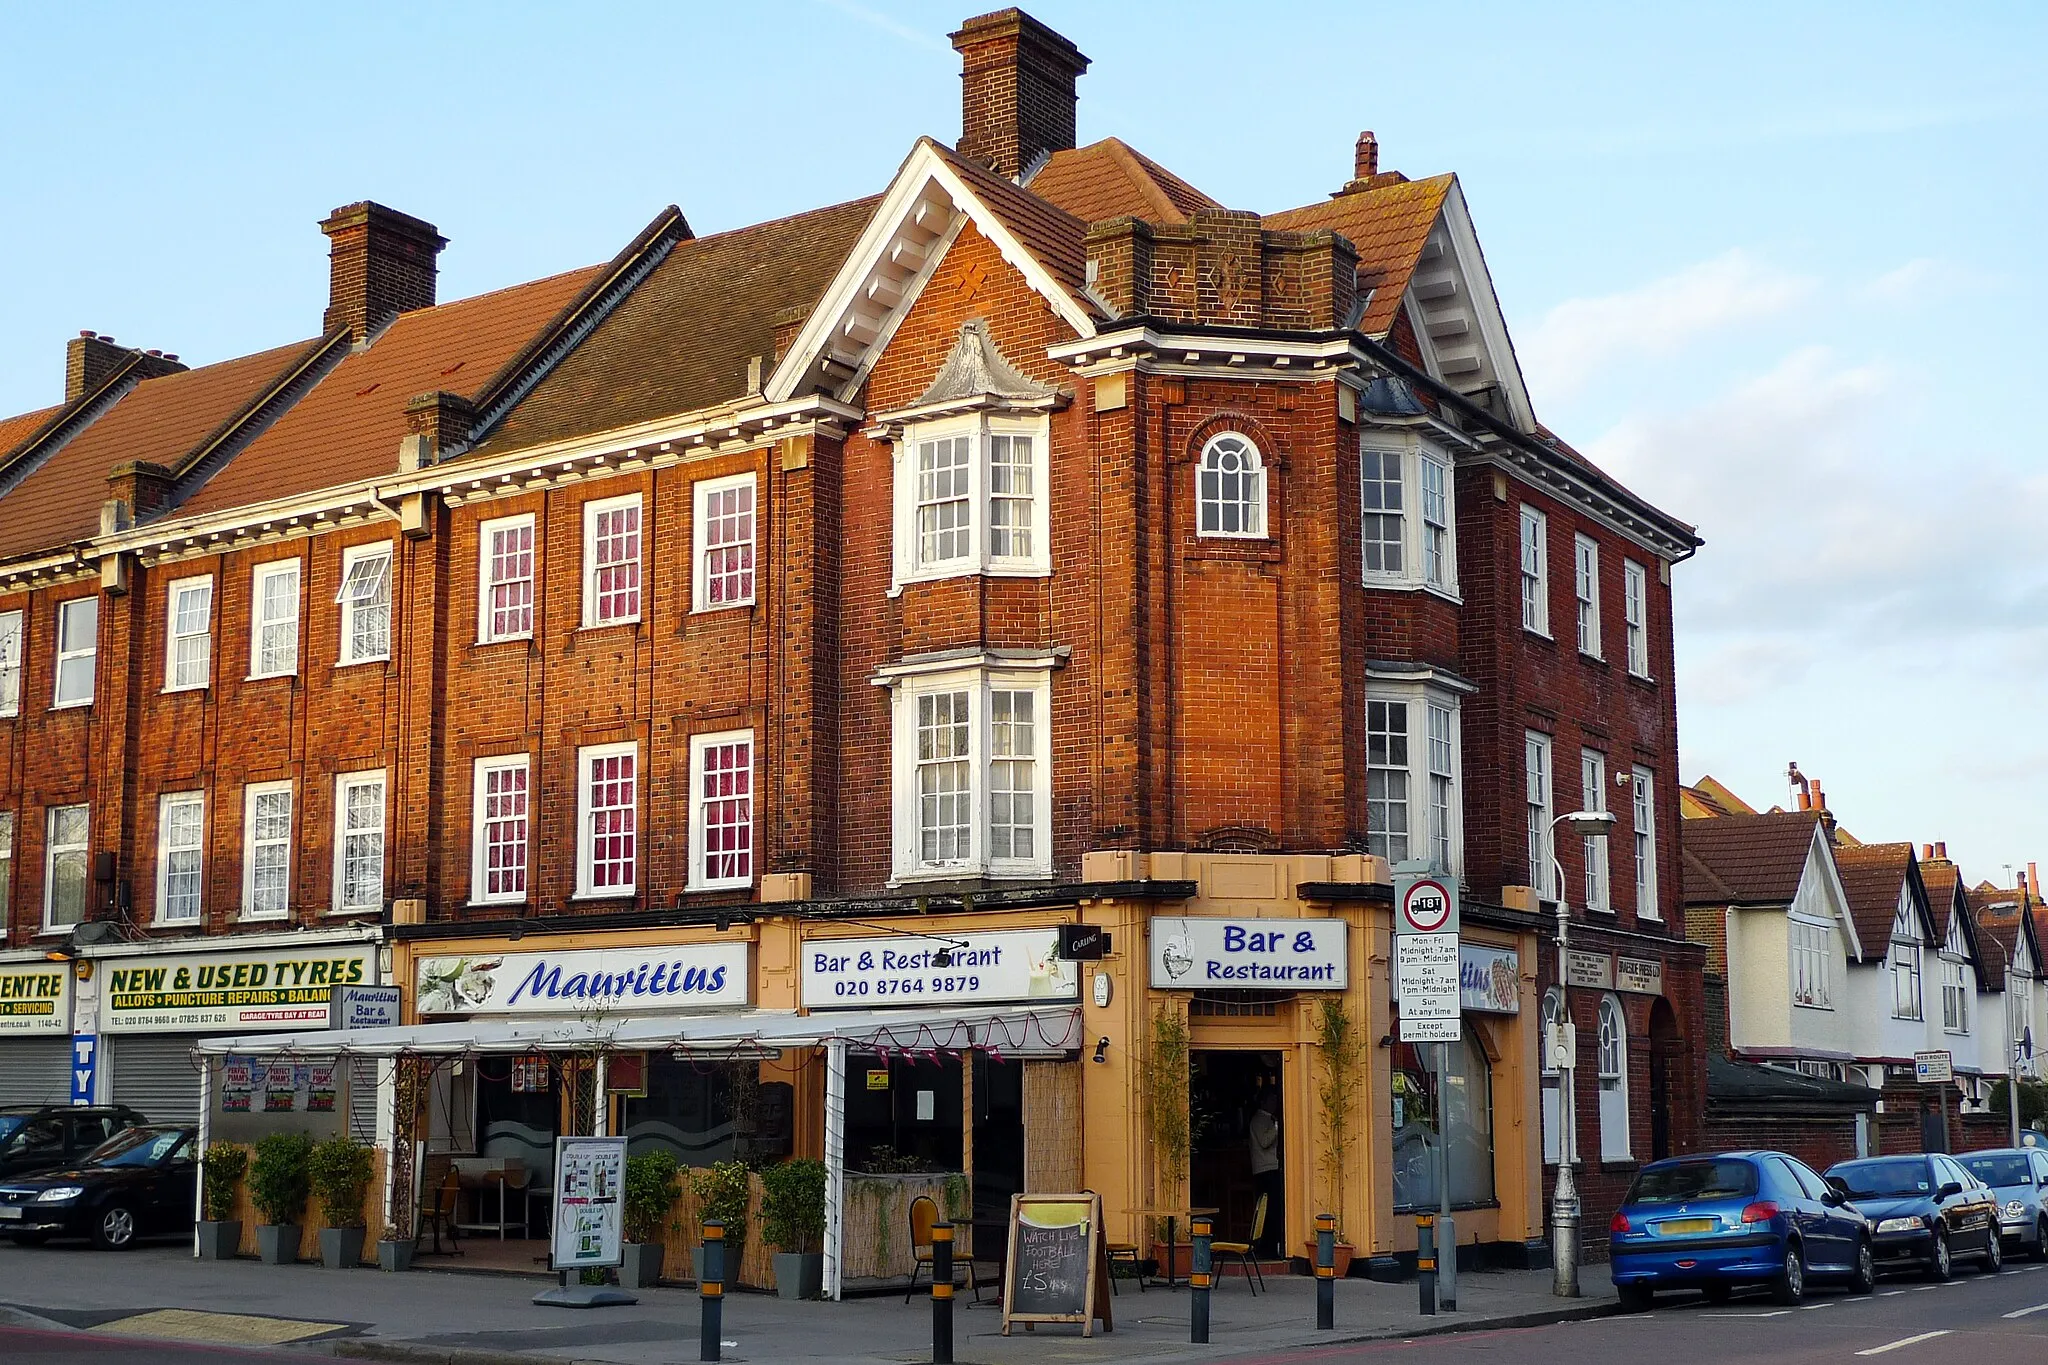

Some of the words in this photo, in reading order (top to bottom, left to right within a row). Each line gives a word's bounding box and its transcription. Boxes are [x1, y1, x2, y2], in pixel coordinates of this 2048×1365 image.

[1421, 897, 1441, 909] 18T
[1072, 933, 1097, 952] CARLING
[1223, 925, 1285, 953] Bar
[1292, 931, 1316, 953] &
[1411, 937, 1428, 945] Mon
[1433, 936, 1444, 944] Fri
[1400, 946, 1434, 955] Midnight
[814, 953, 851, 973] Bar
[857, 951, 875, 971] &
[1423, 954, 1457, 963] Midnight
[110, 967, 168, 993] NEW
[173, 967, 191, 990] &
[197, 963, 269, 989] USED
[274, 957, 365, 986] TYRES
[1206, 960, 1335, 981] Restaurant
[1421, 967, 1436, 975] Sat
[0, 973, 63, 998] ENTRE
[507, 959, 728, 1006] Mauritius
[835, 980, 869, 996] 020
[876, 978, 925, 995] 8764
[932, 976, 980, 993] 9879
[1401, 977, 1434, 986] Midnight
[1422, 985, 1456, 994] Midnight
[114, 994, 156, 1007] ALLOYS
[164, 992, 225, 1006] PUNCTURE
[227, 990, 278, 1005] REPAIRS
[343, 989, 398, 1003] Mauritius
[1421, 998, 1437, 1006] Sun
[13, 1001, 53, 1014] SERVICING
[355, 1004, 376, 1016] Bar
[377, 1006, 386, 1016] &
[1408, 1008, 1417, 1016] At
[1419, 1009, 1433, 1017] any
[1434, 1007, 1452, 1015] time
[111, 1017, 124, 1026] TEL:
[124, 1016, 137, 1025] 020
[200, 1014, 212, 1023] 837
[349, 1016, 391, 1025] Restaurant
[1417, 1022, 1443, 1030] Except
[1403, 1030, 1428, 1040] permit
[1429, 1030, 1458, 1038] holders
[74, 1041, 94, 1106] TY
[1023, 1229, 1055, 1243] WATCH
[1059, 1230, 1079, 1241] LIVE
[1025, 1245, 1076, 1258] FOOTBALL
[1032, 1259, 1061, 1270] HERE
